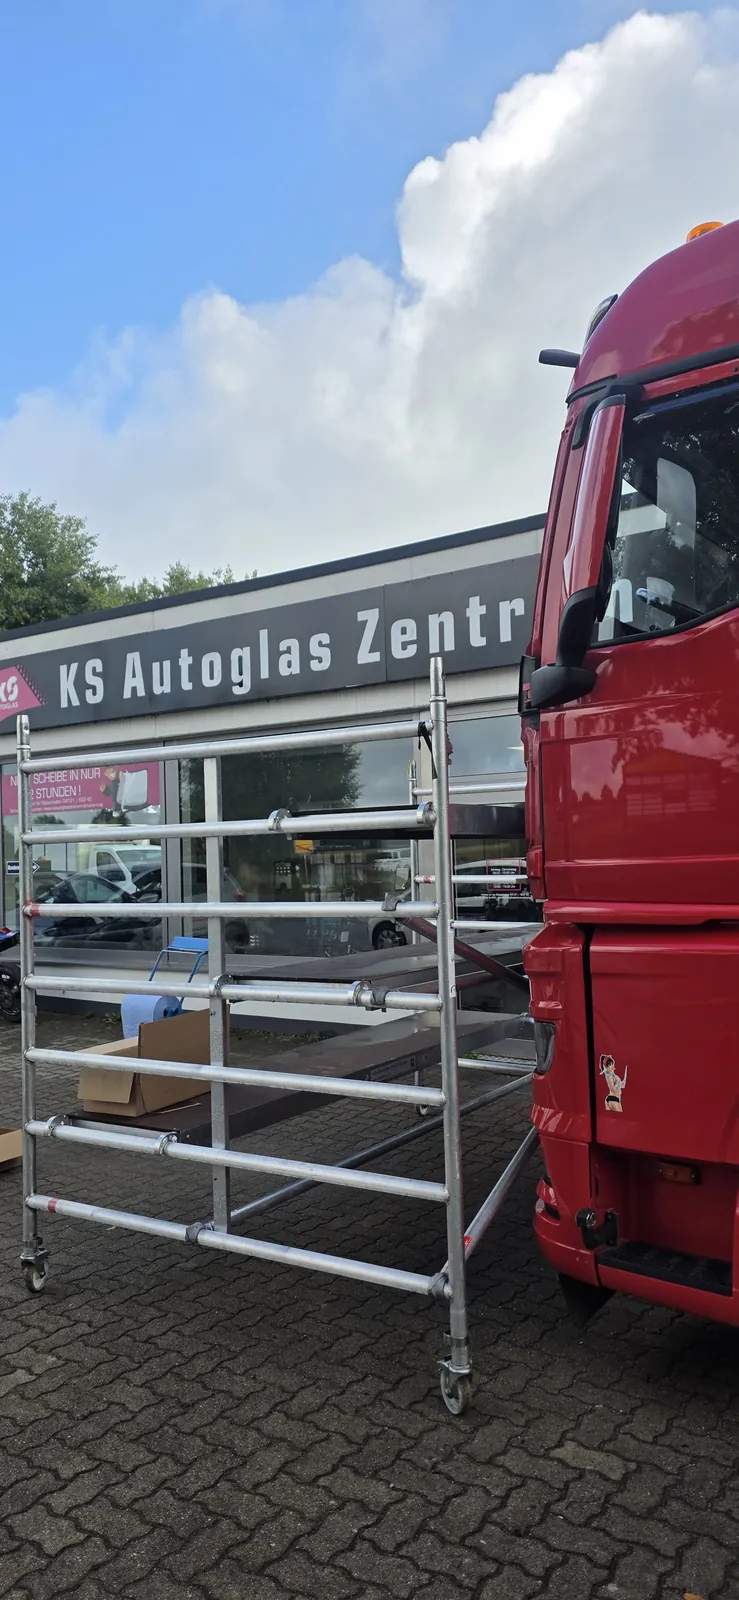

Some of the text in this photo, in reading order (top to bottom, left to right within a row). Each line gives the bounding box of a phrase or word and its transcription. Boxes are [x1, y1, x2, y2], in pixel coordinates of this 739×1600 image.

[59, 658, 104, 708] KS
[123, 629, 331, 699] Autoglas
[33, 770, 67, 784] SCHEIBE
[69, 769, 79, 781] IN
[80, 767, 101, 780] NUR
[36, 786, 77, 799] STUNDEN
